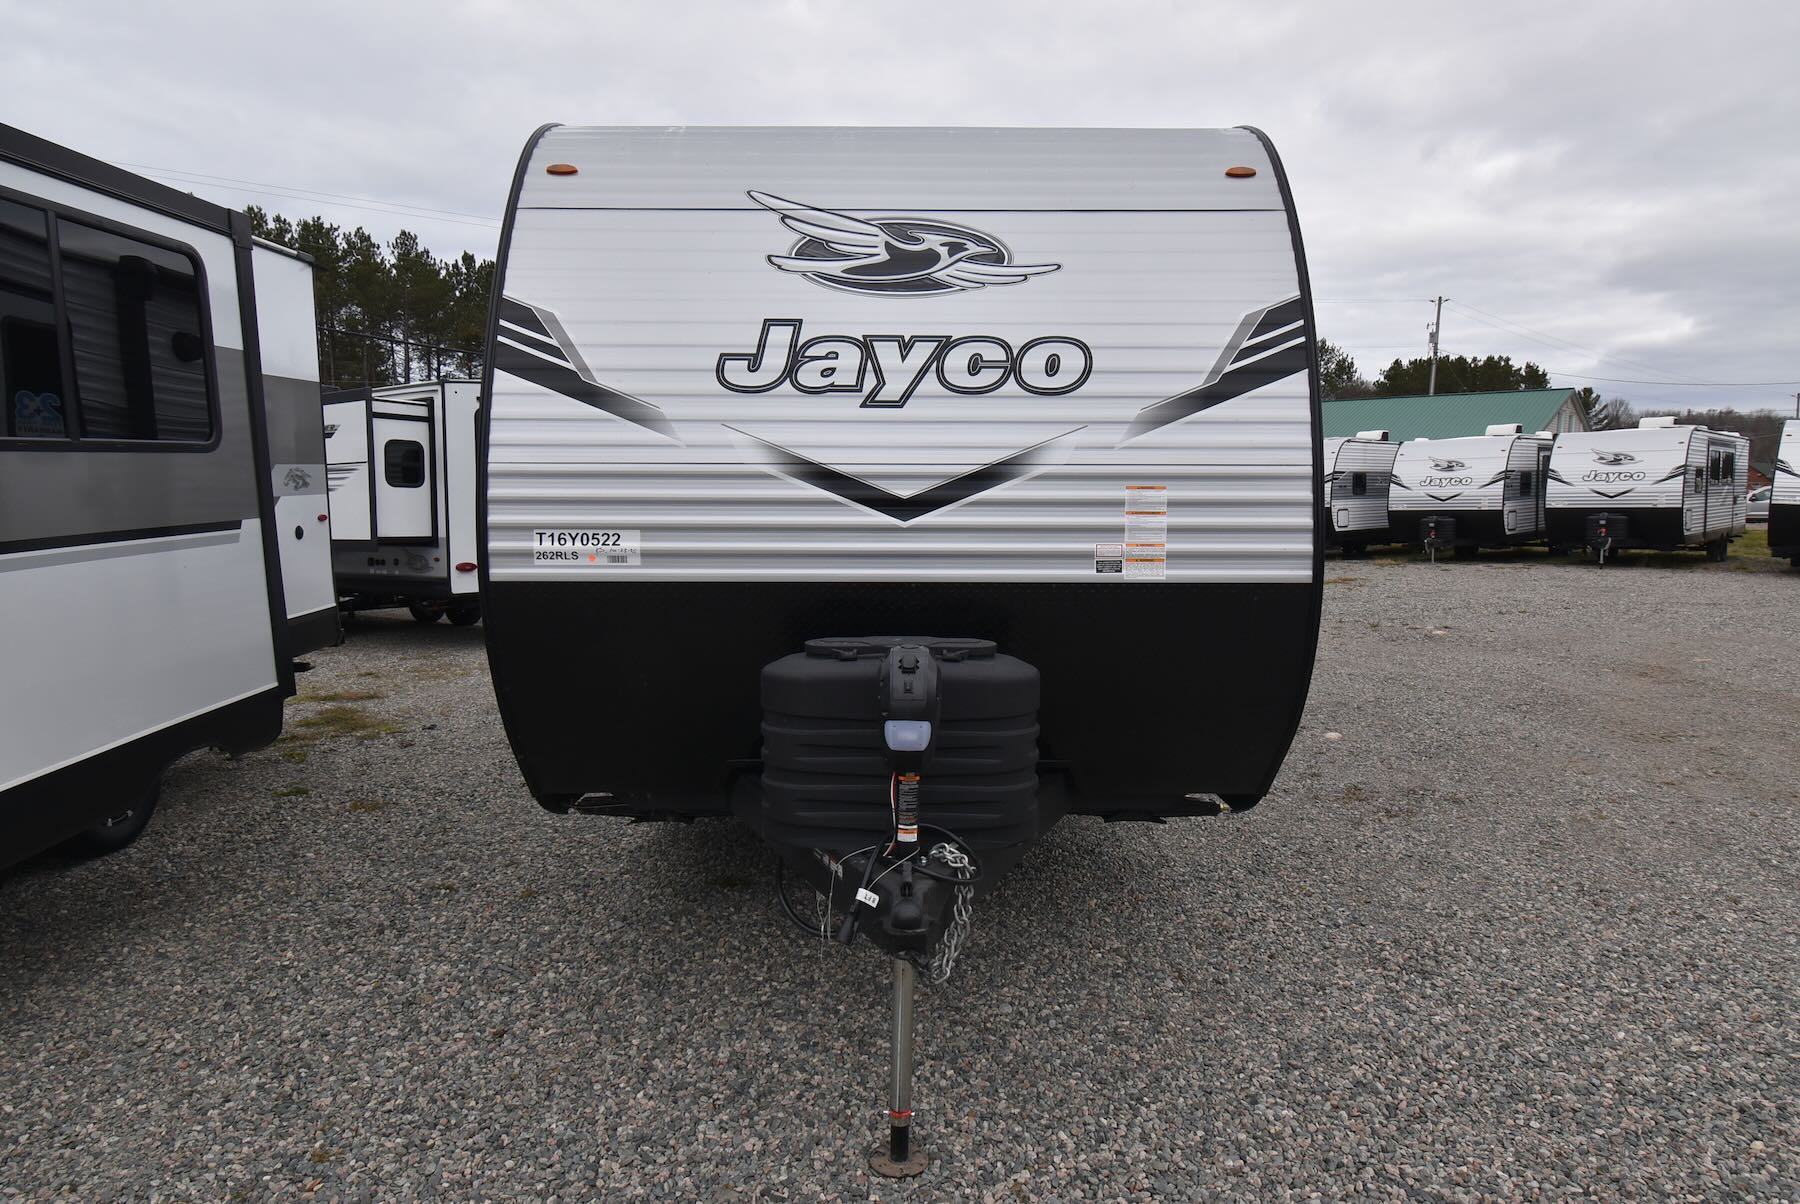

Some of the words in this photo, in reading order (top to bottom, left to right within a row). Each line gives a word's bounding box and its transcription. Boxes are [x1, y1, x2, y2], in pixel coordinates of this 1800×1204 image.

[715, 318, 1093, 408] Jayco
[1419, 475, 1472, 488] Jayco
[1582, 469, 1646, 483] Jayco
[535, 532, 621, 547] T16Y0522
[535, 551, 579, 561] 262RLS
